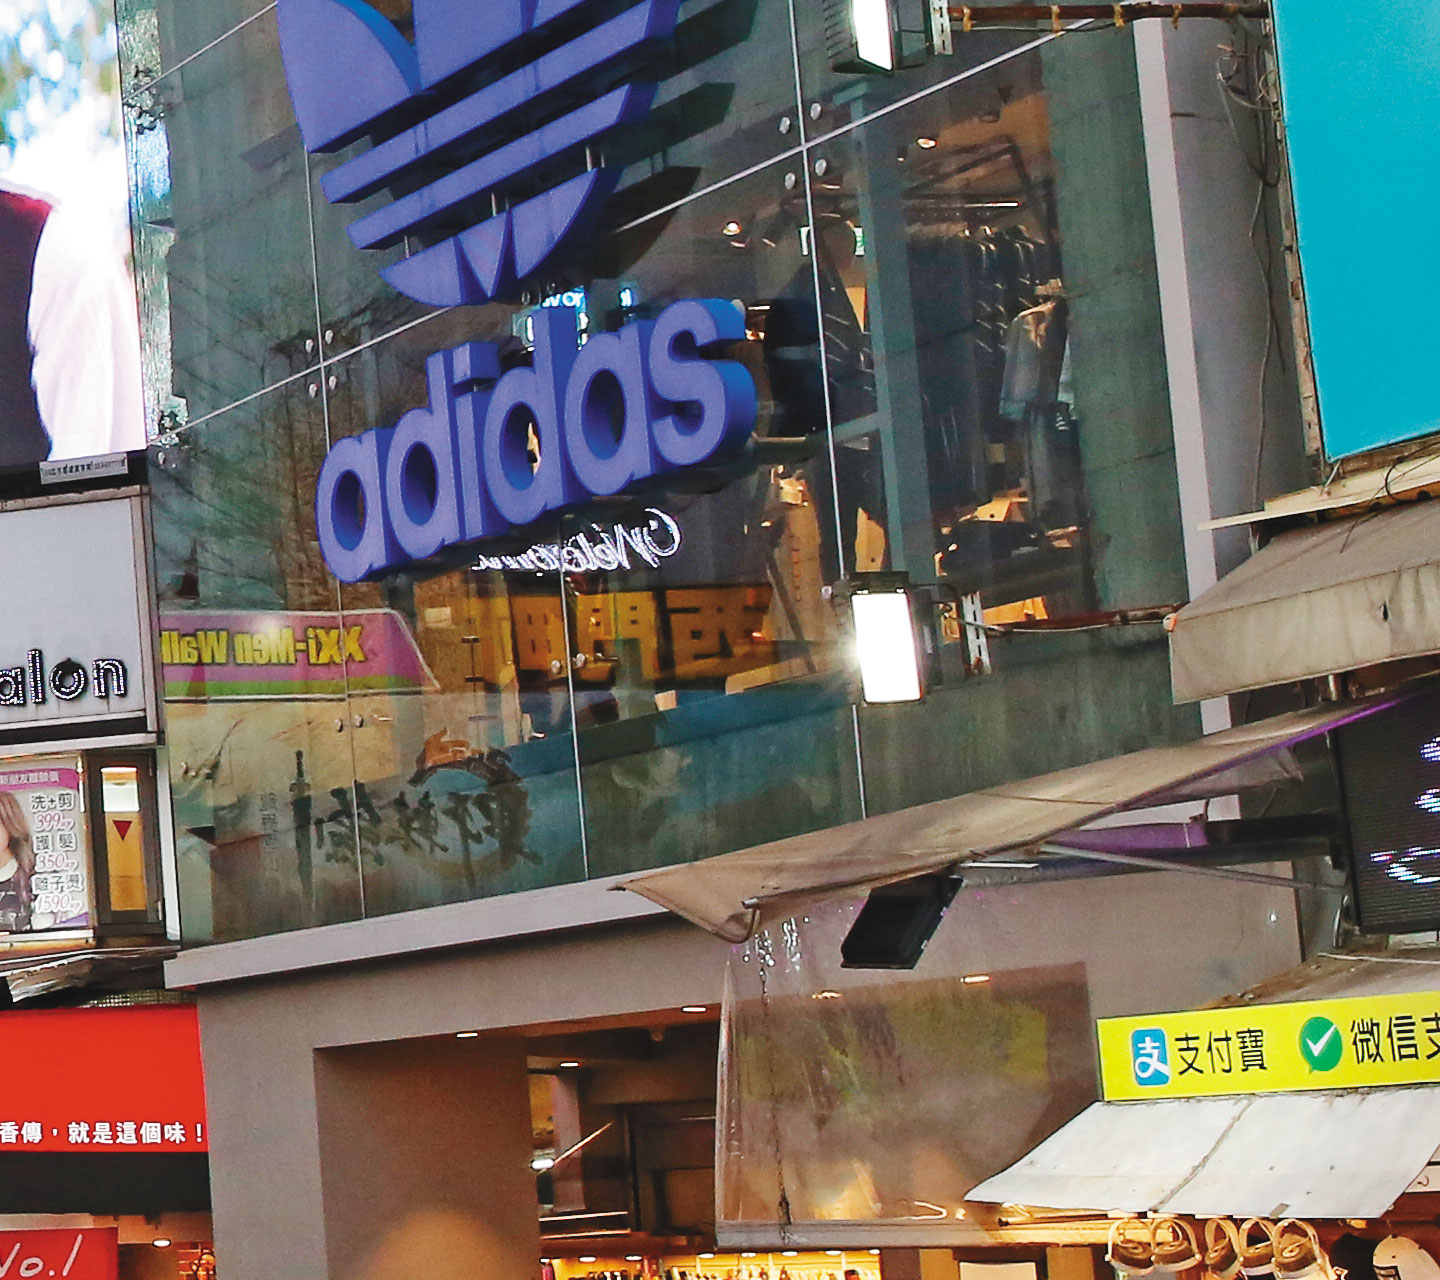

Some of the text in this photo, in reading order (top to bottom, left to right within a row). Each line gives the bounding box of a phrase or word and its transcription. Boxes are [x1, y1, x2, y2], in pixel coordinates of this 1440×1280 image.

[314, 295, 761, 585] adidas
[1174, 1028, 1268, 1076] 支付寶
